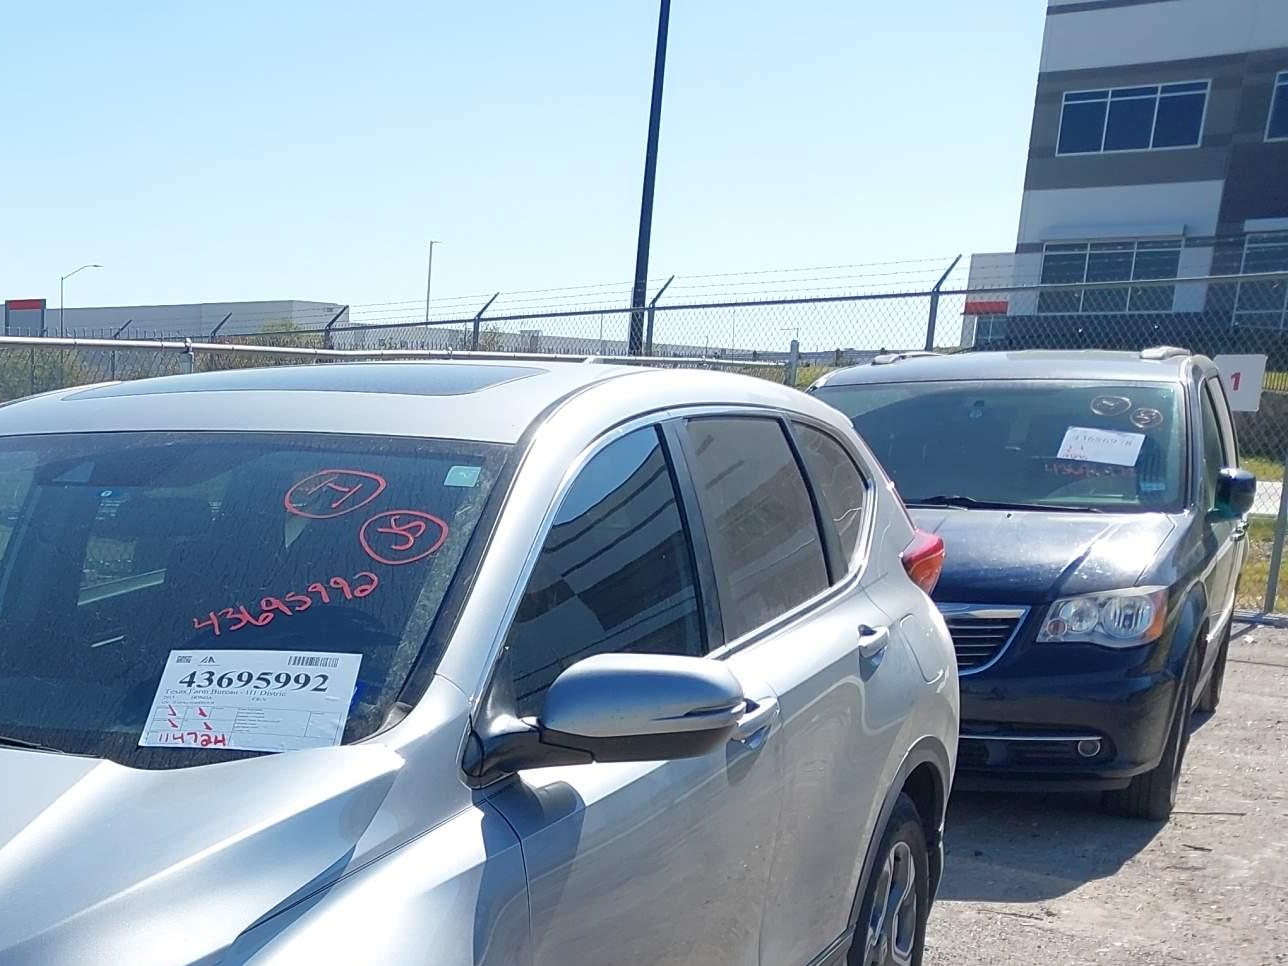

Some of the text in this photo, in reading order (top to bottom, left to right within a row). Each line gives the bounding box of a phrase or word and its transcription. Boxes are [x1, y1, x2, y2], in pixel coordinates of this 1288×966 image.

[1230, 372, 1241, 391] 1
[192, 571, 379, 636] 43695992
[178, 670, 329, 693] 43695992
